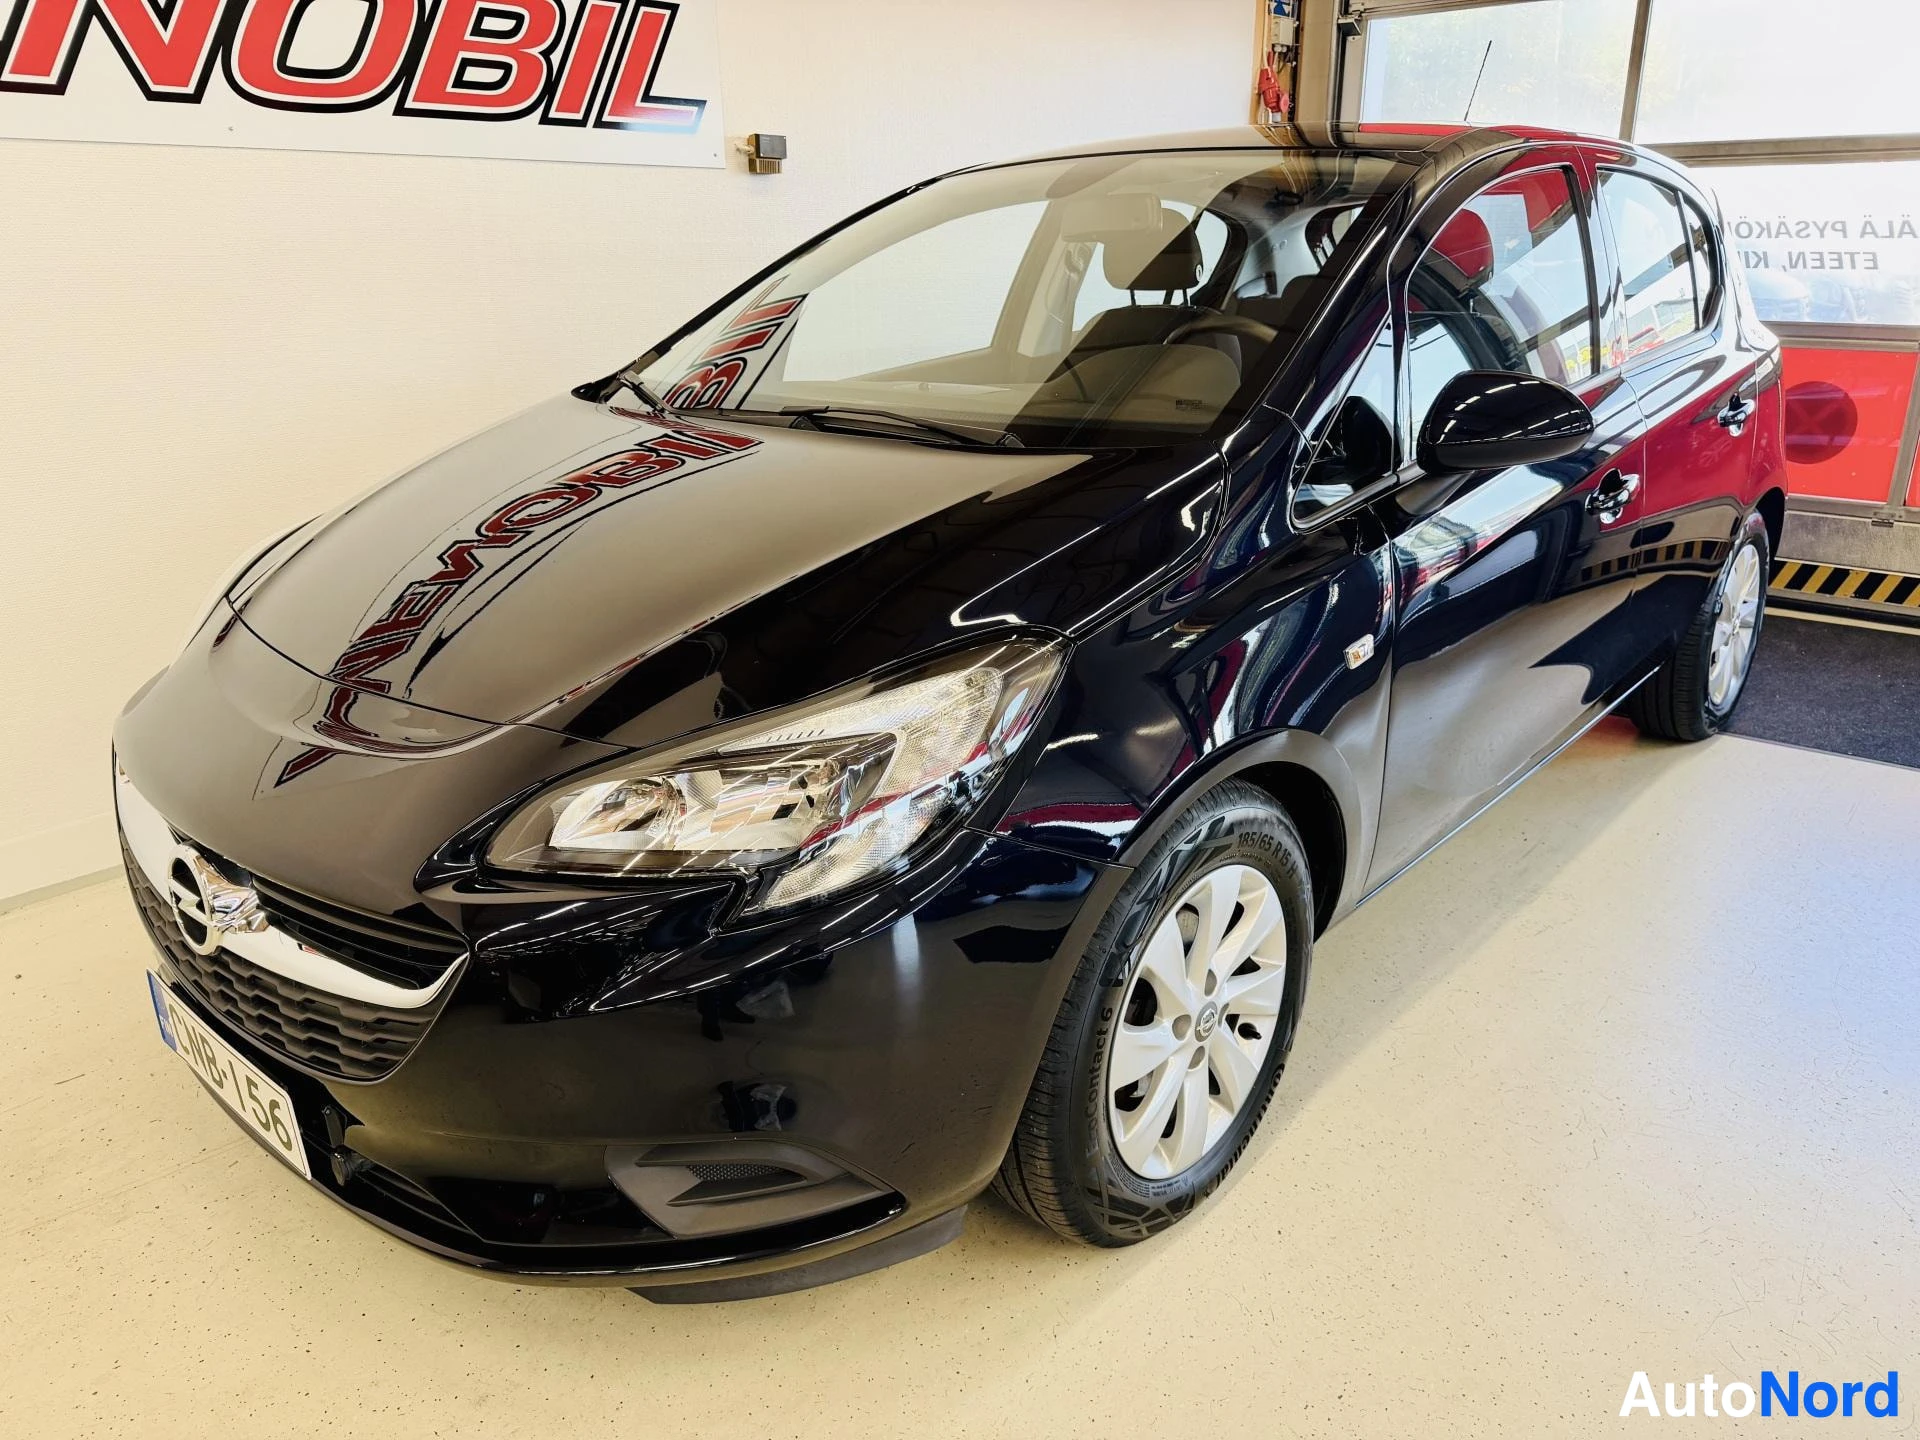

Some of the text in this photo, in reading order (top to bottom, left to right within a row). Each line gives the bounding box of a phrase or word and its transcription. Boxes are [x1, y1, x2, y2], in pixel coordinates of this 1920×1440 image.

[1238, 831, 1274, 852] 185/65
[1271, 840, 1283, 858] R
[1279, 847, 1292, 866] 15
[1101, 1006, 1113, 1022] 6
